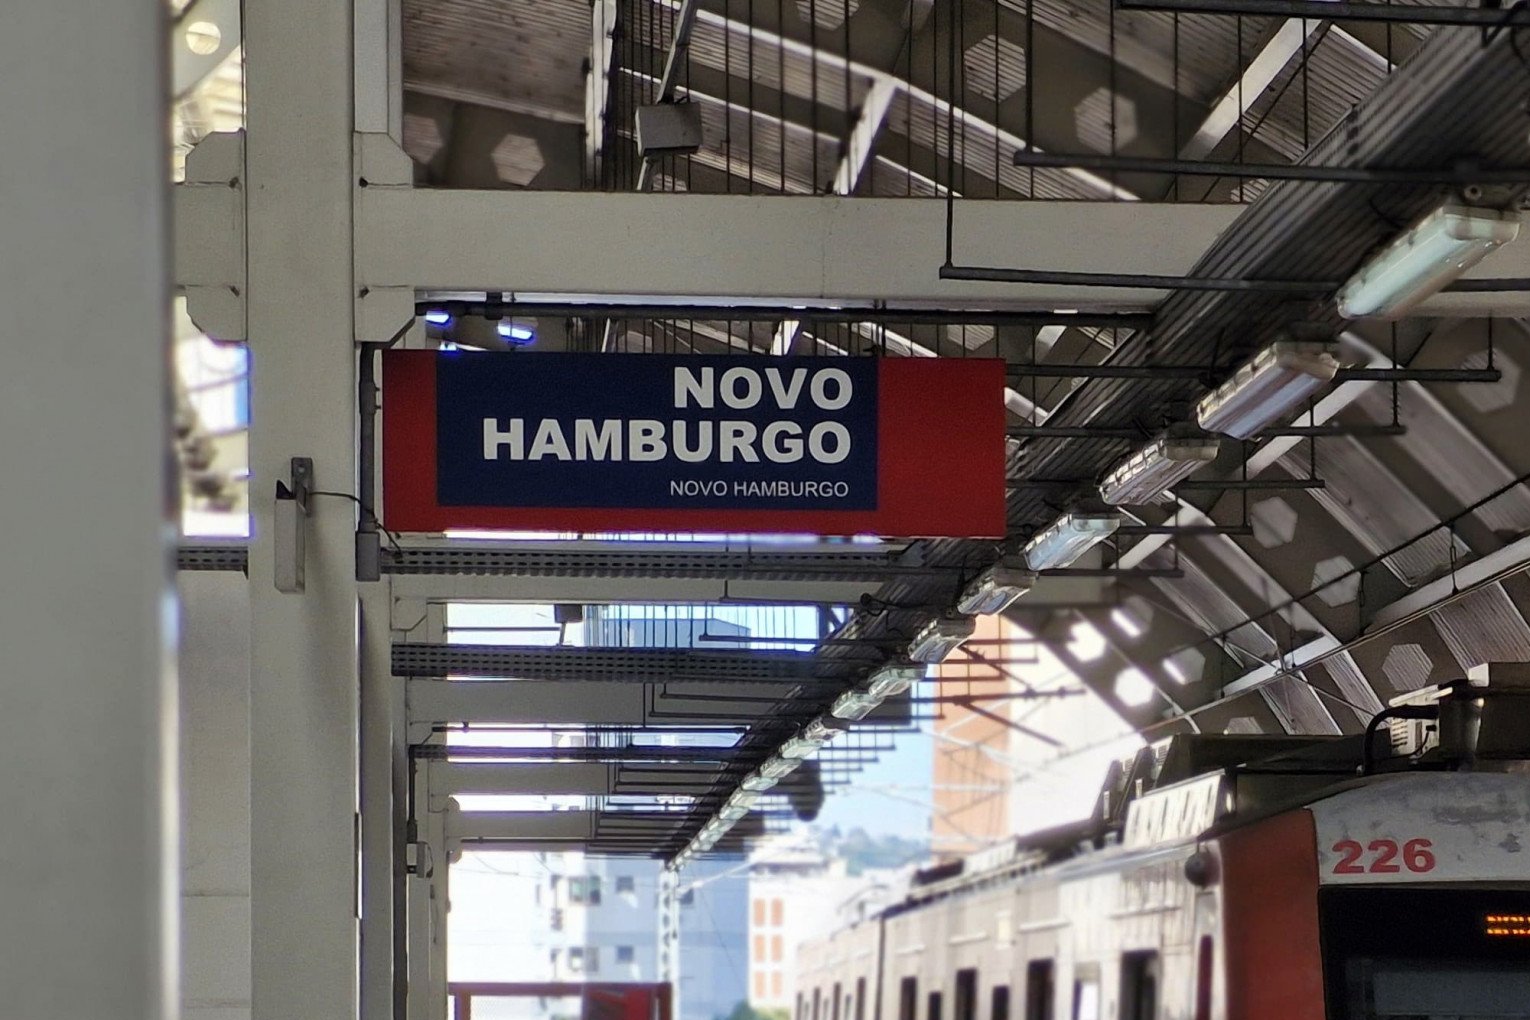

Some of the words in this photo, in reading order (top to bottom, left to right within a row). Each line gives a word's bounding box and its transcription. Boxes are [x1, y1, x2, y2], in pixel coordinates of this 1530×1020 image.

[673, 366, 853, 411] NOVO
[482, 417, 852, 464] HAMBURGO
[669, 479, 728, 498] NOVO
[733, 479, 850, 499] HAMBURGO
[1332, 837, 1436, 875] 226
